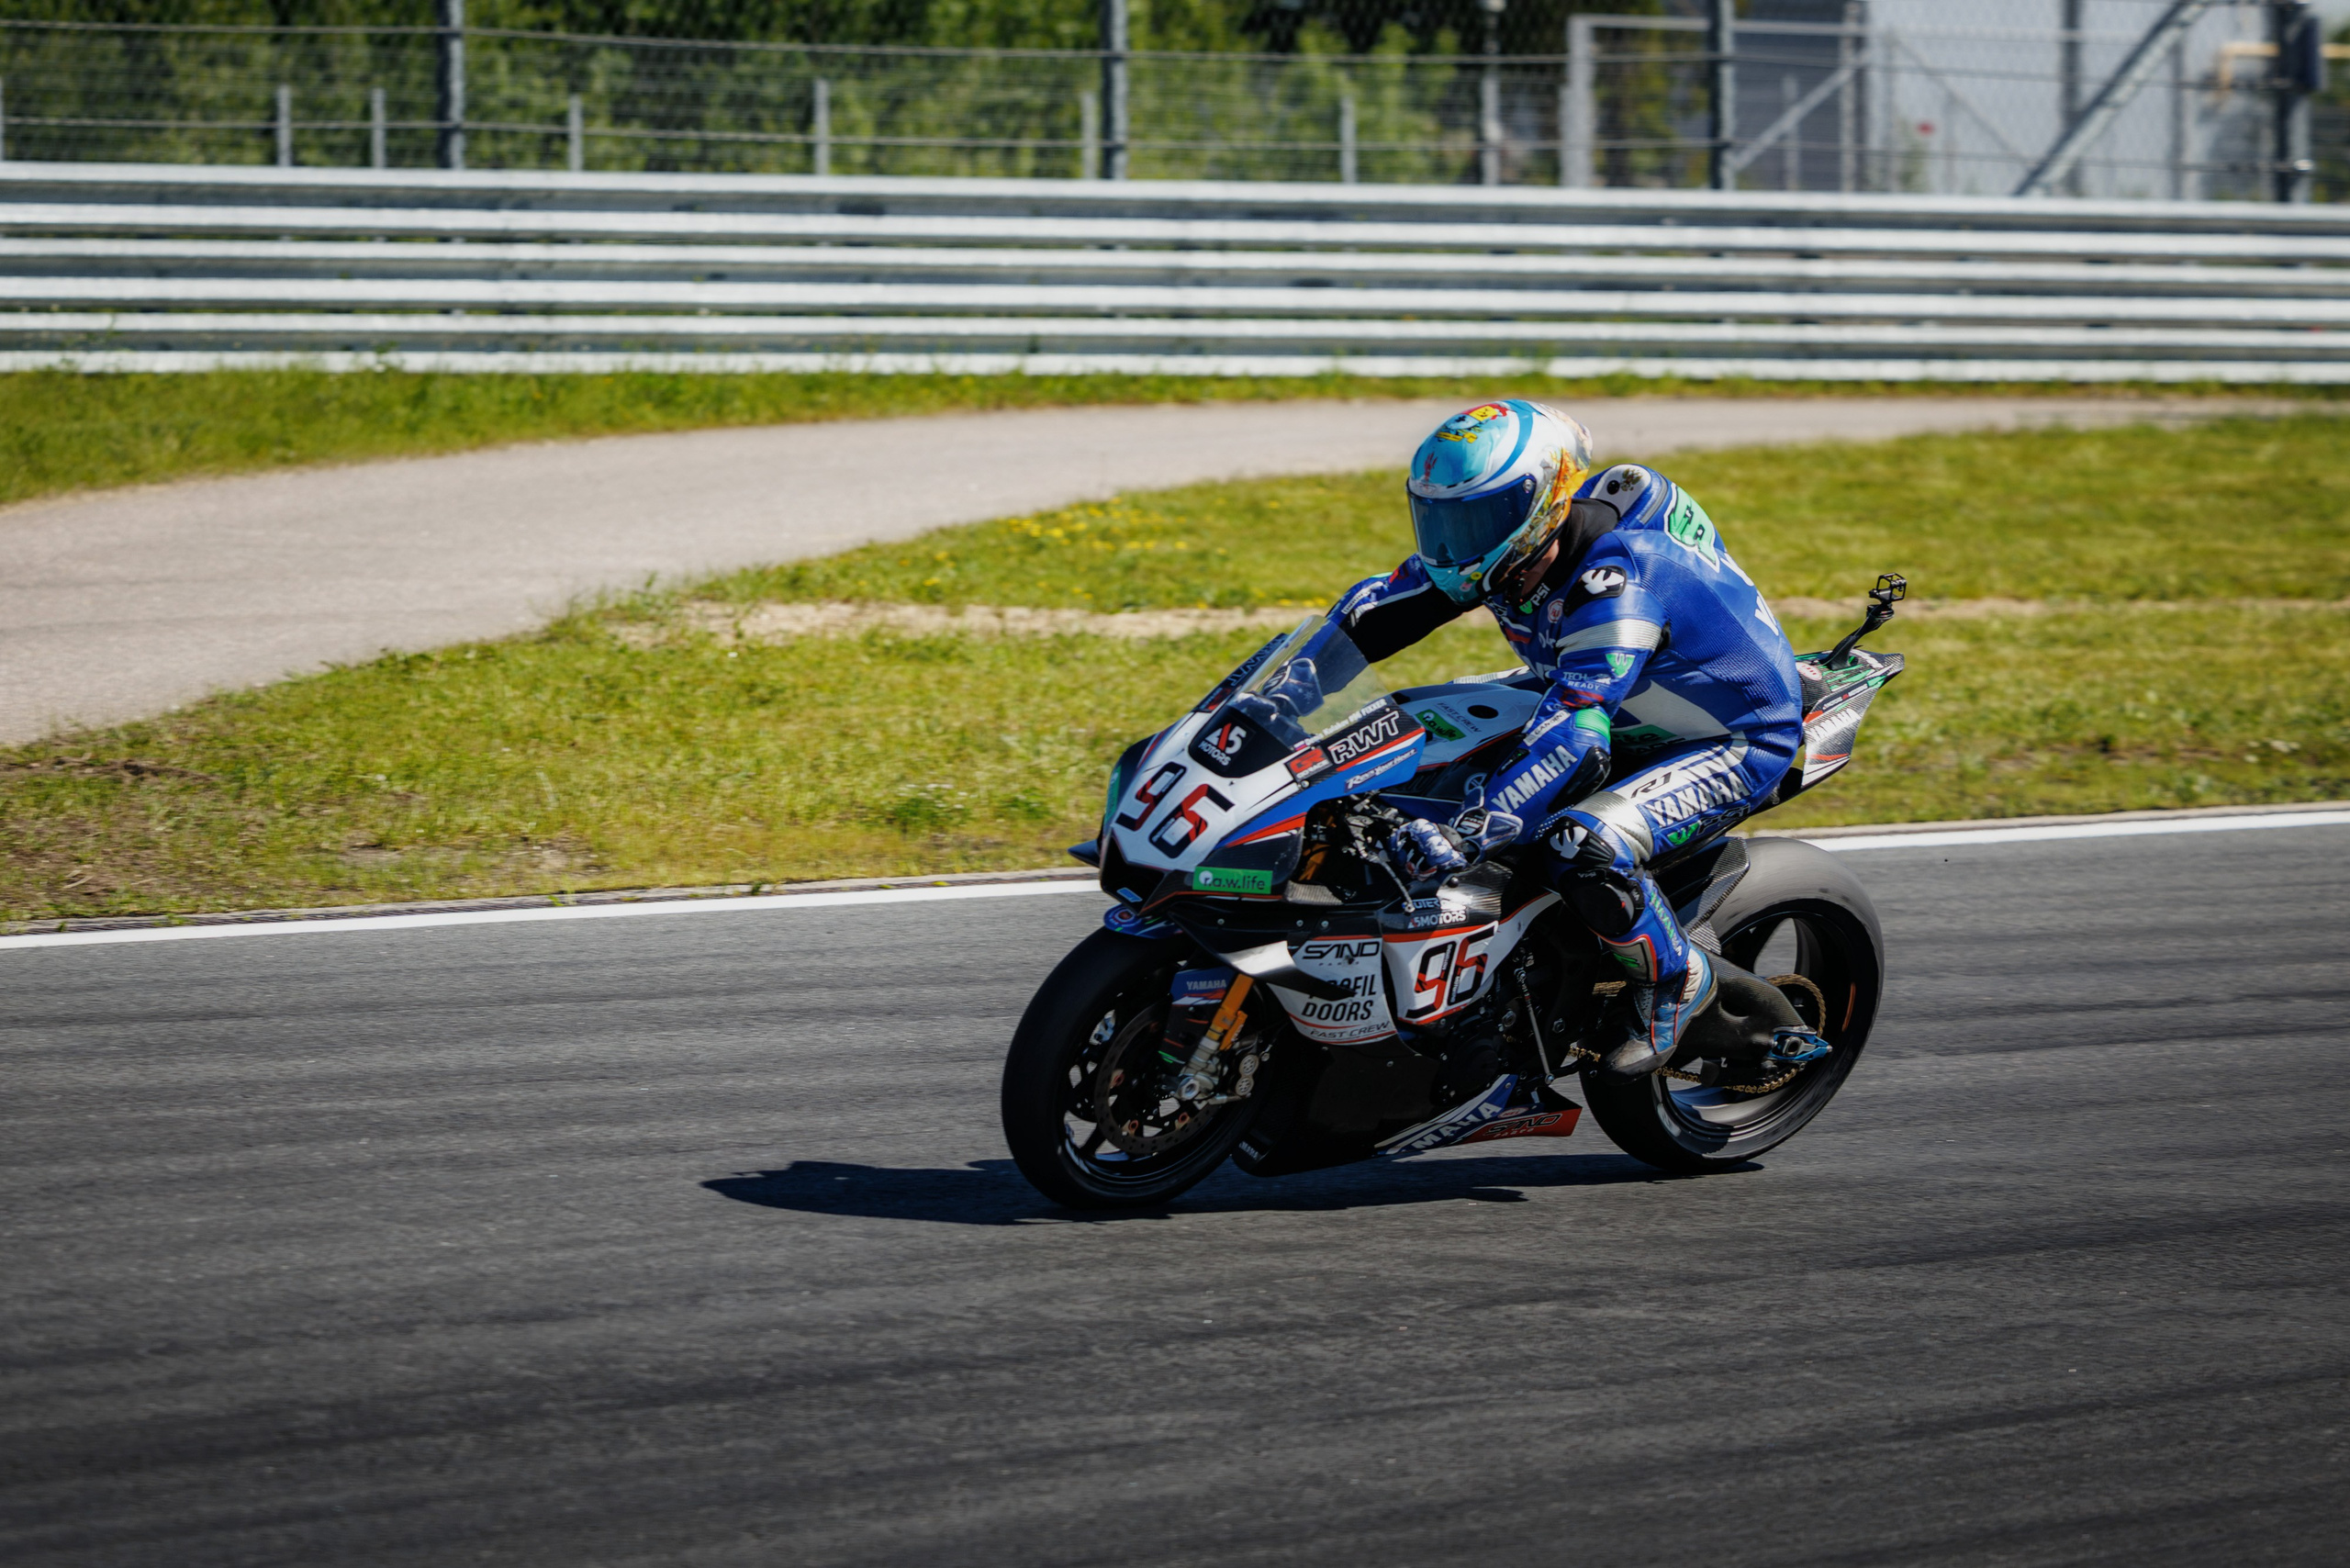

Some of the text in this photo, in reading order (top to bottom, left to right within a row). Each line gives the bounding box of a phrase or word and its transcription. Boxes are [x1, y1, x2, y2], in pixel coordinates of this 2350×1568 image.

[1568, 681, 1601, 691] READY
[1327, 710, 1400, 765] RWT
[1198, 740, 1232, 767] MOTORS
[1490, 745, 1579, 815] YAMAHA
[1114, 761, 1237, 859] 96
[1203, 874, 1266, 891] r.a.w.life
[1302, 941, 1381, 960] SAND
[1405, 925, 1496, 1019] 96
[1186, 979, 1227, 991] YAMAHA
[1310, 974, 1377, 999] OFIL
[1301, 1000, 1374, 1022] DOORS
[1310, 1021, 1390, 1039] FAST CREW
[1401, 1102, 1504, 1152] MAHA
[1485, 1114, 1561, 1136] SAND
